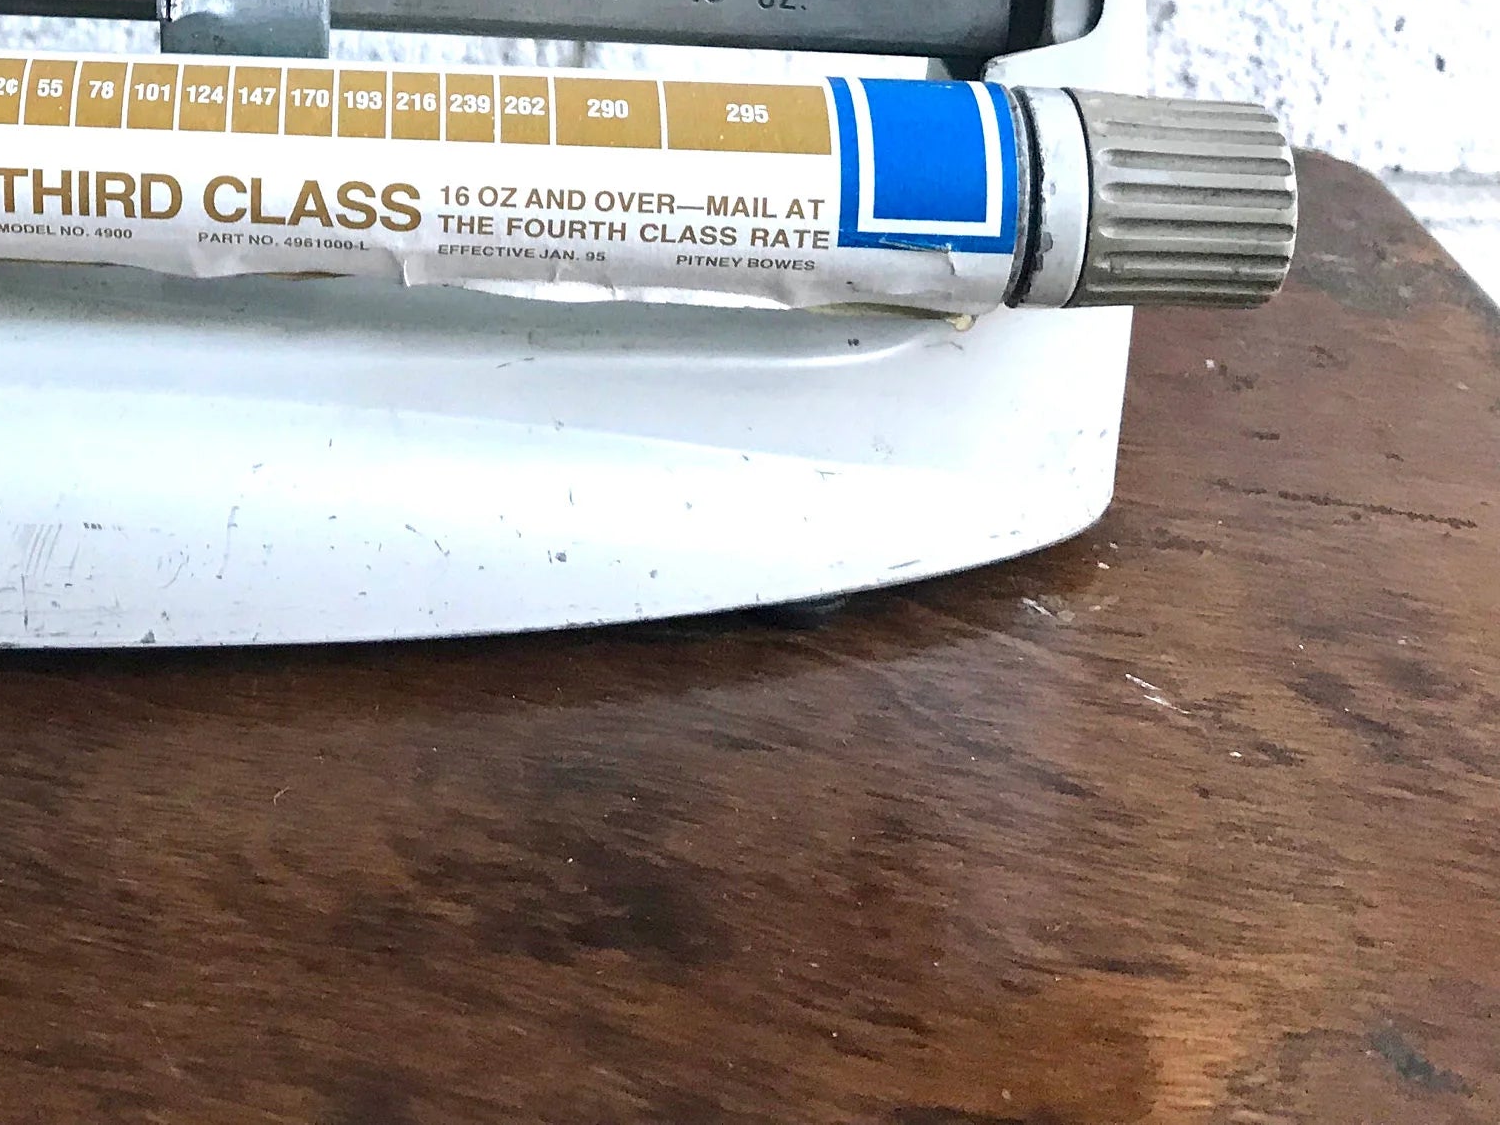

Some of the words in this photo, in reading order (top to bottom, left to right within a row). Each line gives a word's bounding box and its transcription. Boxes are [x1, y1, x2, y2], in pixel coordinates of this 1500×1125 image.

[36, 78, 63, 98] 55
[88, 80, 115, 101] 78
[134, 82, 172, 104] 101
[186, 84, 224, 106] 124
[237, 86, 277, 107] 147
[290, 88, 330, 109] 170
[343, 90, 383, 111] 193
[395, 91, 437, 113] 216
[449, 92, 491, 115] 239
[504, 94, 545, 117] 262
[586, 98, 629, 120] 290
[725, 102, 769, 124] 295
[202, 175, 422, 232] CLASS
[440, 185, 470, 207] 16
[478, 186, 517, 209] OZ
[524, 187, 587, 211] AND
[785, 198, 826, 220] AT
[60, 226, 90, 238] NO.
[94, 227, 133, 240] 4900
[198, 231, 244, 246] PART
[248, 234, 279, 248] NO.
[437, 214, 494, 237] THE
[506, 217, 627, 242] FOURTH
[639, 222, 737, 247] CLASS
[750, 227, 830, 251] RATE
[437, 243, 536, 260] EFFECTIVE
[539, 247, 579, 262] JAN.
[585, 250, 606, 263] 95
[676, 253, 741, 269] PITNEY
[747, 258, 816, 272] BOWES
